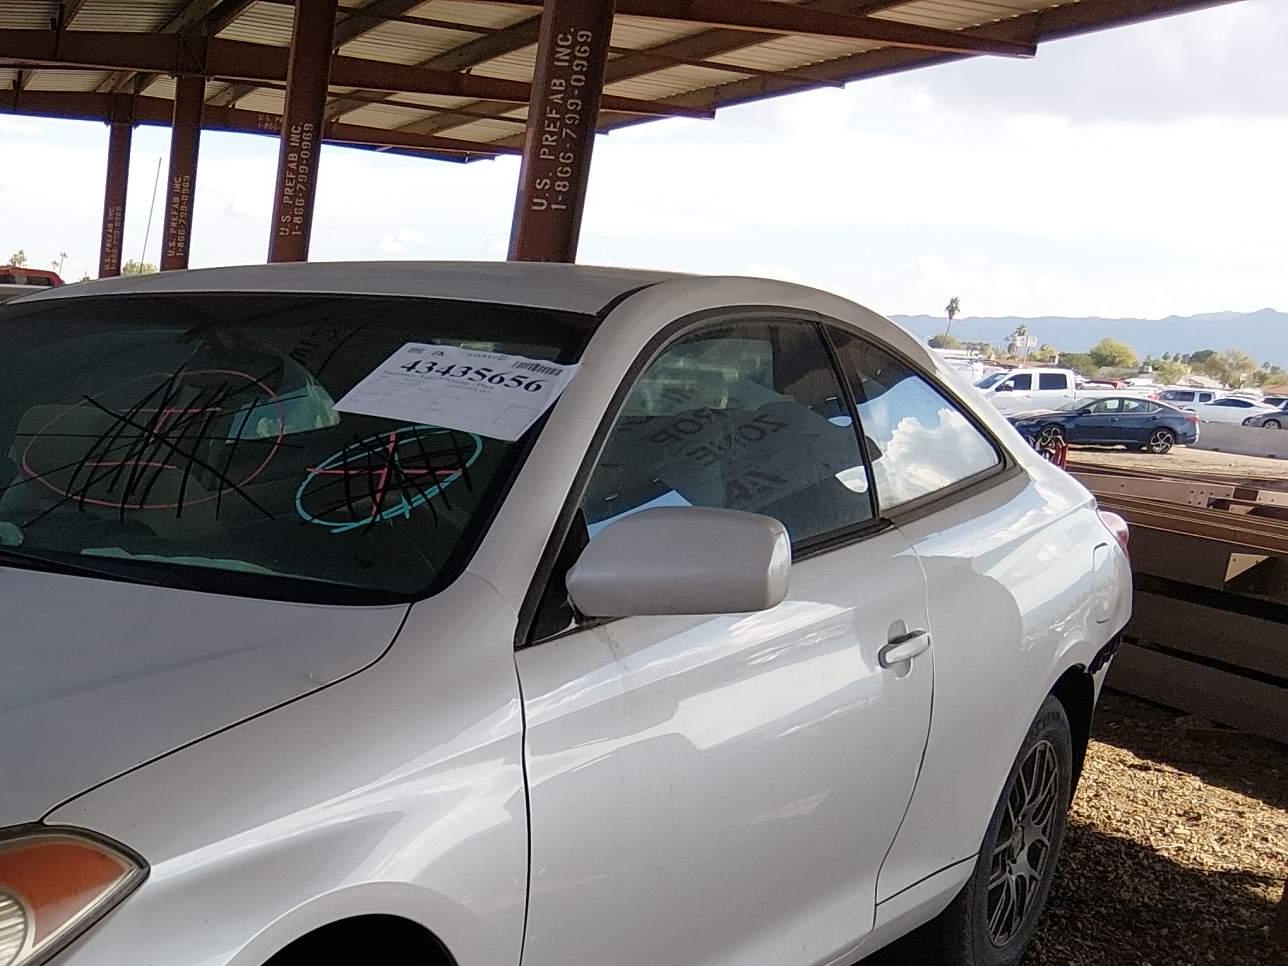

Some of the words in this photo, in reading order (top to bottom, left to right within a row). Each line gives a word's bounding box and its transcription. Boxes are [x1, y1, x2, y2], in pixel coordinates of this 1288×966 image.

[554, 27, 575, 67] INC.
[290, 121, 303, 147] INC.
[540, 78, 566, 160] PREFAB
[551, 30, 593, 210] 1-866-799-0969
[283, 153, 299, 204] PREFAB
[292, 123, 313, 235] 1-866-799-0969
[532, 171, 554, 211] U.S.
[279, 211, 293, 236] U.S.
[400, 358, 548, 393] 43435656
